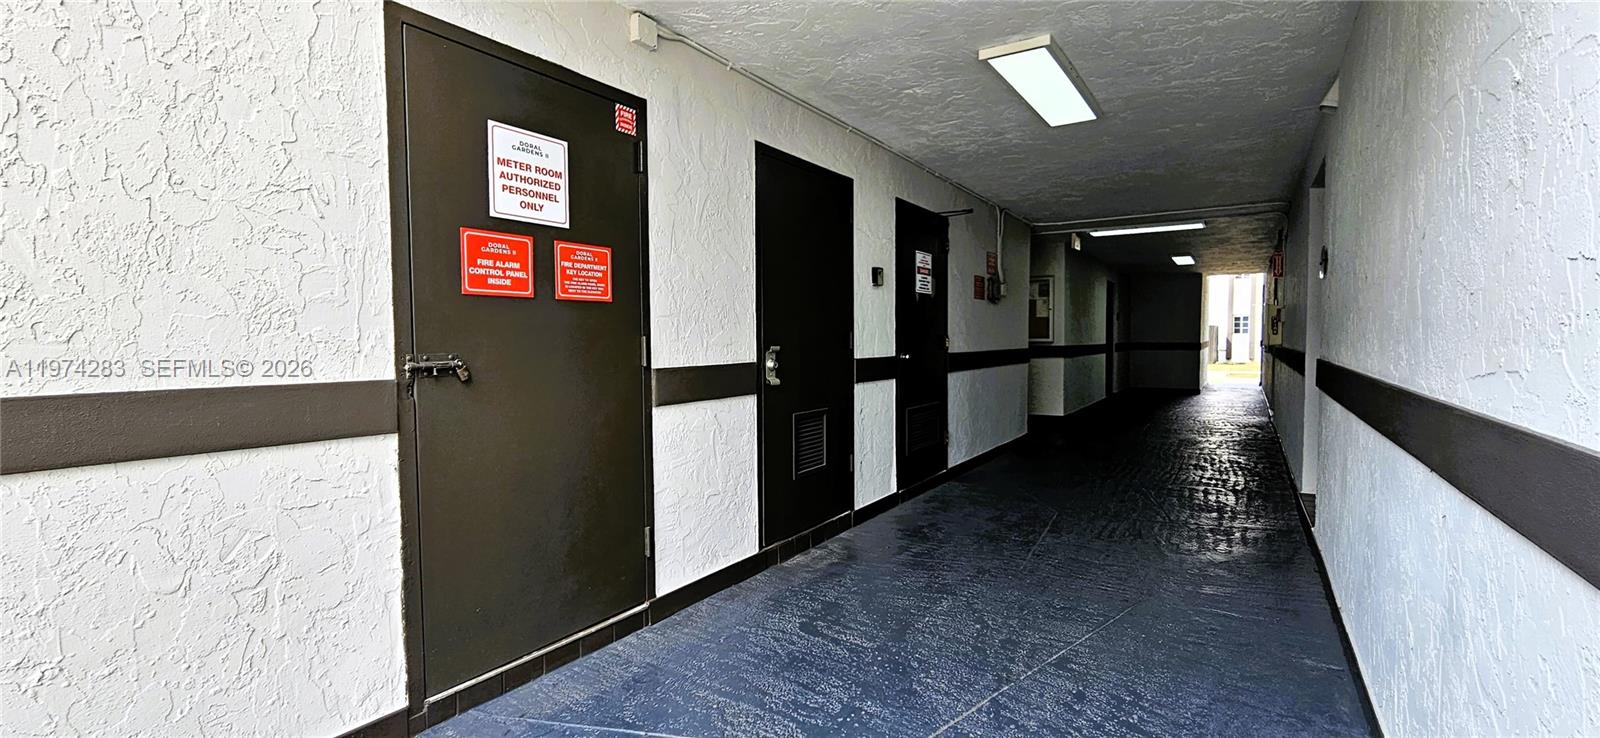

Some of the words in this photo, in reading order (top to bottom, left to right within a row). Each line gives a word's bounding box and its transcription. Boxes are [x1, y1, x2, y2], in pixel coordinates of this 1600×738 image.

[620, 110, 633, 120] FIRE
[511, 144, 543, 158] GARDENS
[519, 140, 542, 151] DORAL
[496, 156, 532, 173] METER
[534, 165, 563, 180] ROOM
[499, 170, 562, 191] AUTHORIZED
[501, 183, 560, 204] PERSONNEL
[520, 201, 544, 212] ONLY
[481, 247, 511, 255] GARDENS
[477, 258, 494, 267] FIRE
[495, 260, 521, 269] ALARM
[574, 263, 607, 271] DEPARTMENT
[468, 266, 505, 277] CONTROL
[505, 270, 529, 279] PANEL
[488, 278, 511, 286] INSIDE
